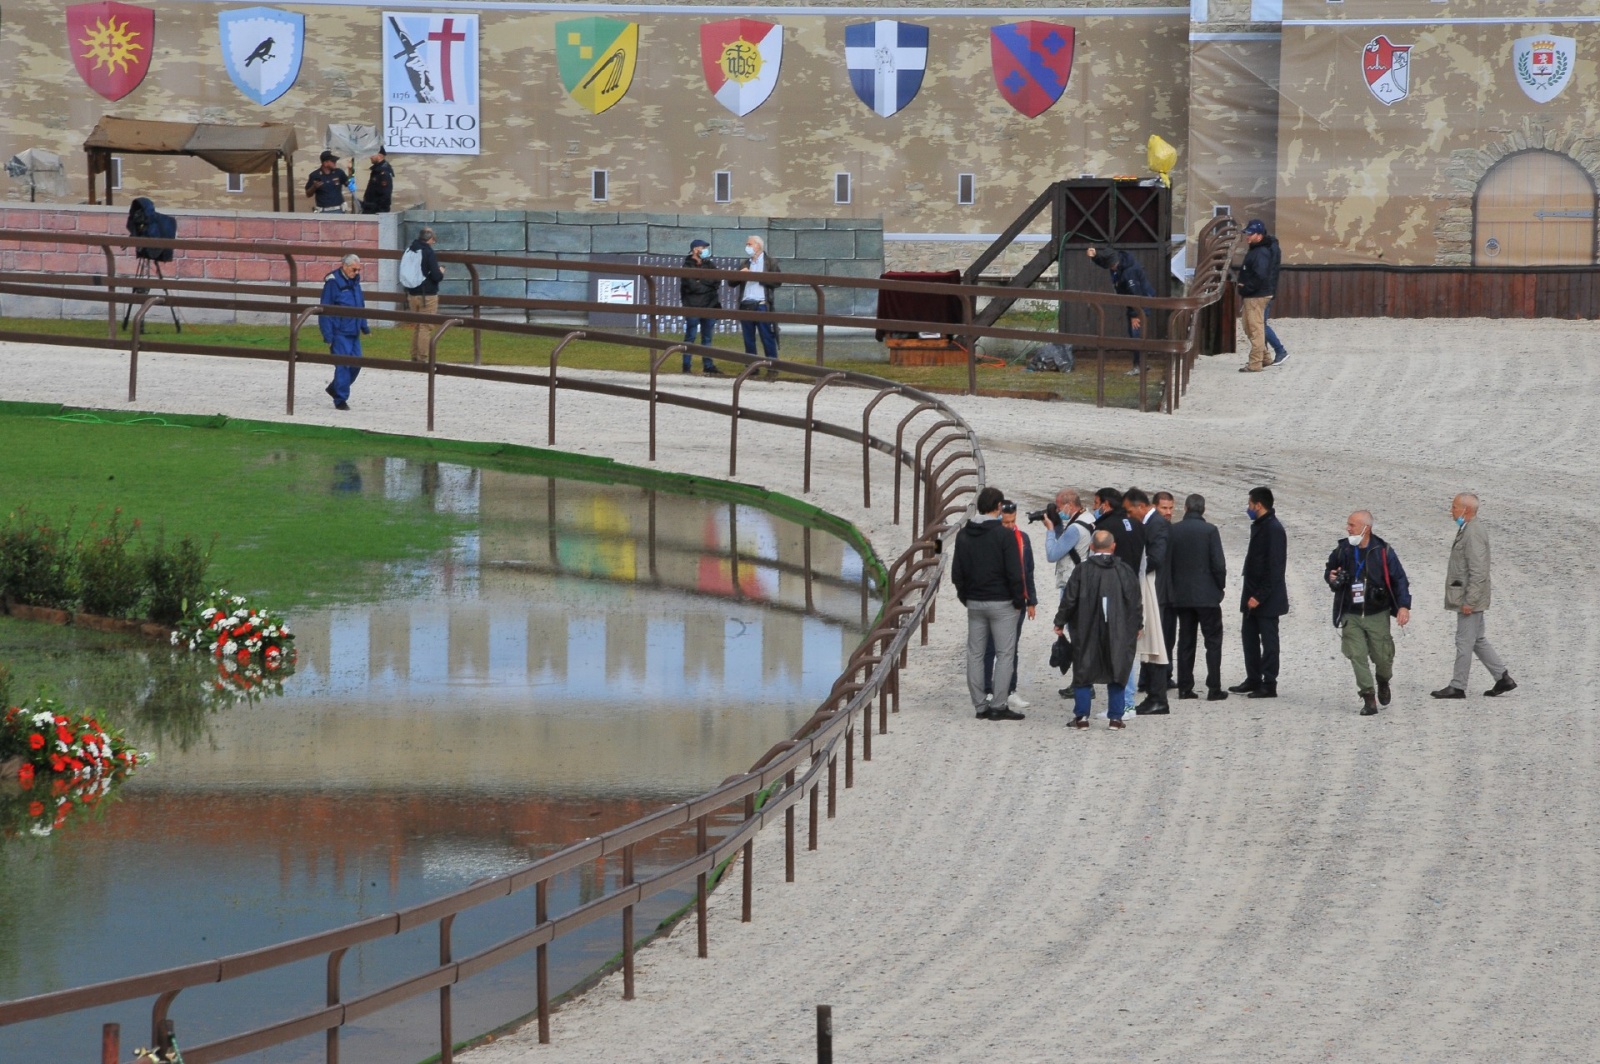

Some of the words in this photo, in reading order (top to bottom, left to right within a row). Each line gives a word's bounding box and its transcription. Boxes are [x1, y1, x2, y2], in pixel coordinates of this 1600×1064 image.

[392, 91, 410, 100] 1176
[387, 106, 476, 131] PALIO
[390, 126, 403, 137] di
[387, 136, 476, 149] LEGNANO
